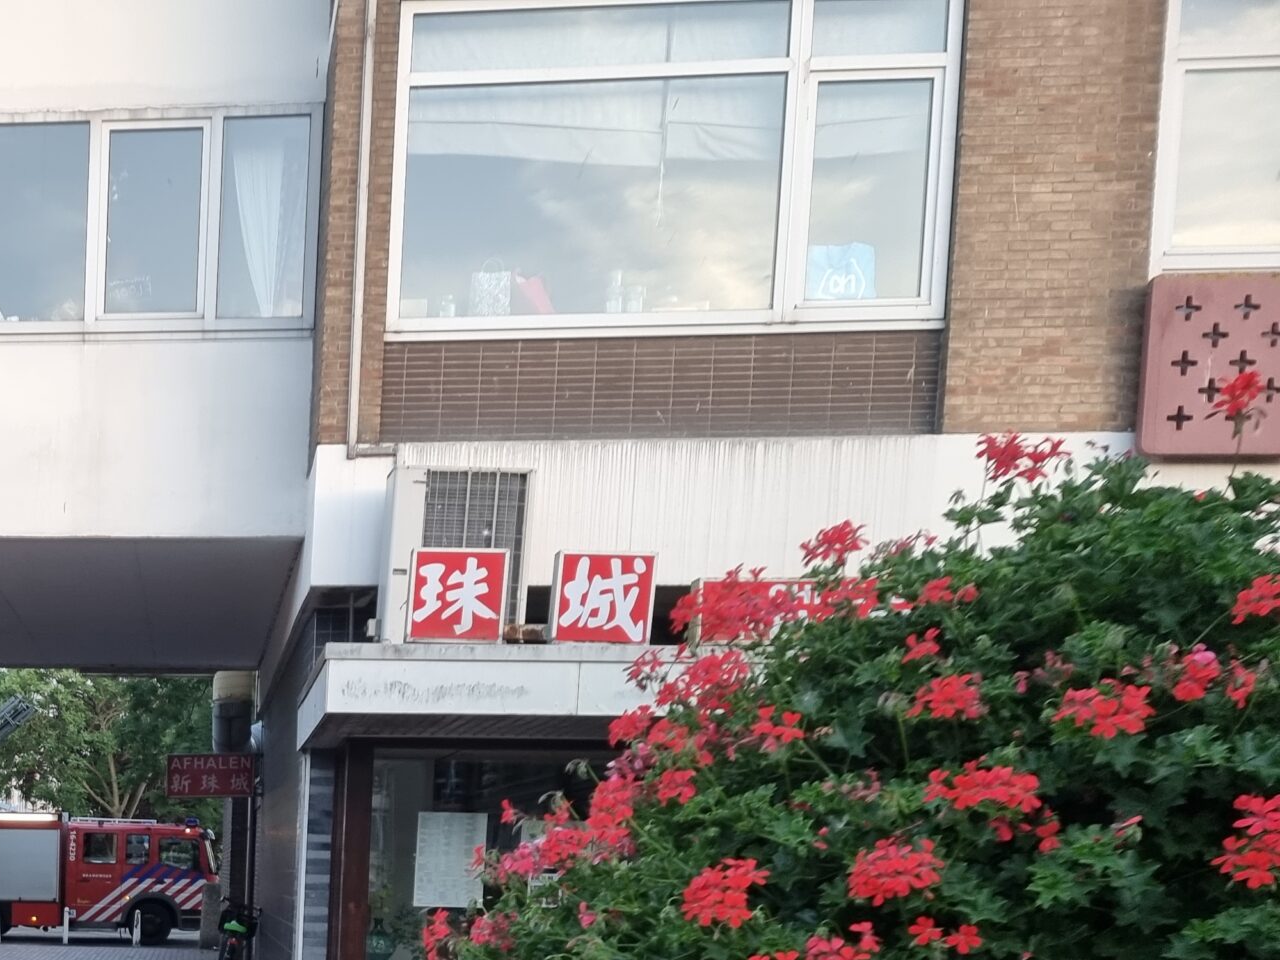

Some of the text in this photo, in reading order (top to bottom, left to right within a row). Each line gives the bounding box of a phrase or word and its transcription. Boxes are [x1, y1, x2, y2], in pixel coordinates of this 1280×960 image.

[413, 556, 647, 642] 珠 城
[170, 756, 251, 769] AFHALEN
